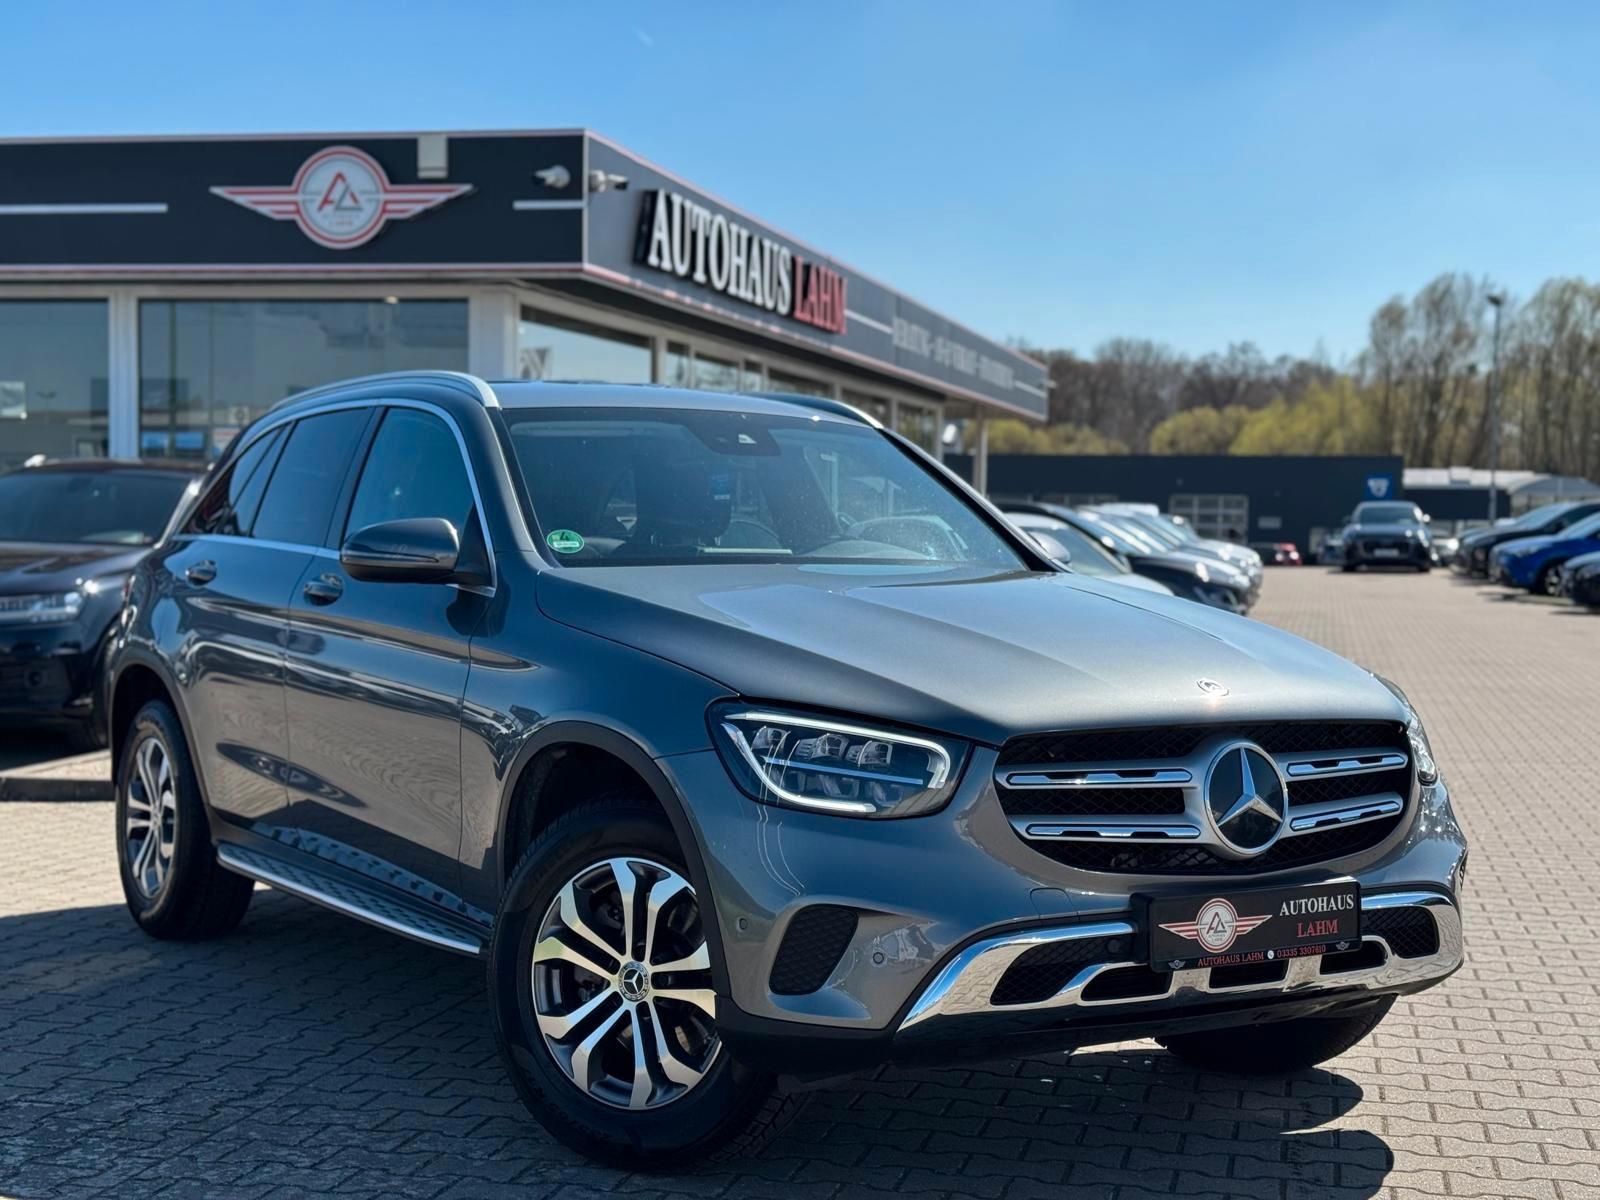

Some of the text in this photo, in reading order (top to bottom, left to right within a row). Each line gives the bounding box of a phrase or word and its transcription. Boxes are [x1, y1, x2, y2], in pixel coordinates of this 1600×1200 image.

[647, 190, 848, 335] AUTOHAUS LAHM
[1280, 894, 1354, 916] AUTOHAUS
[1297, 919, 1338, 938] LAHM
[1198, 954, 1240, 966] AUTOHAUS
[1242, 952, 1264, 962] LAHM
[1277, 947, 1297, 958] 03335
